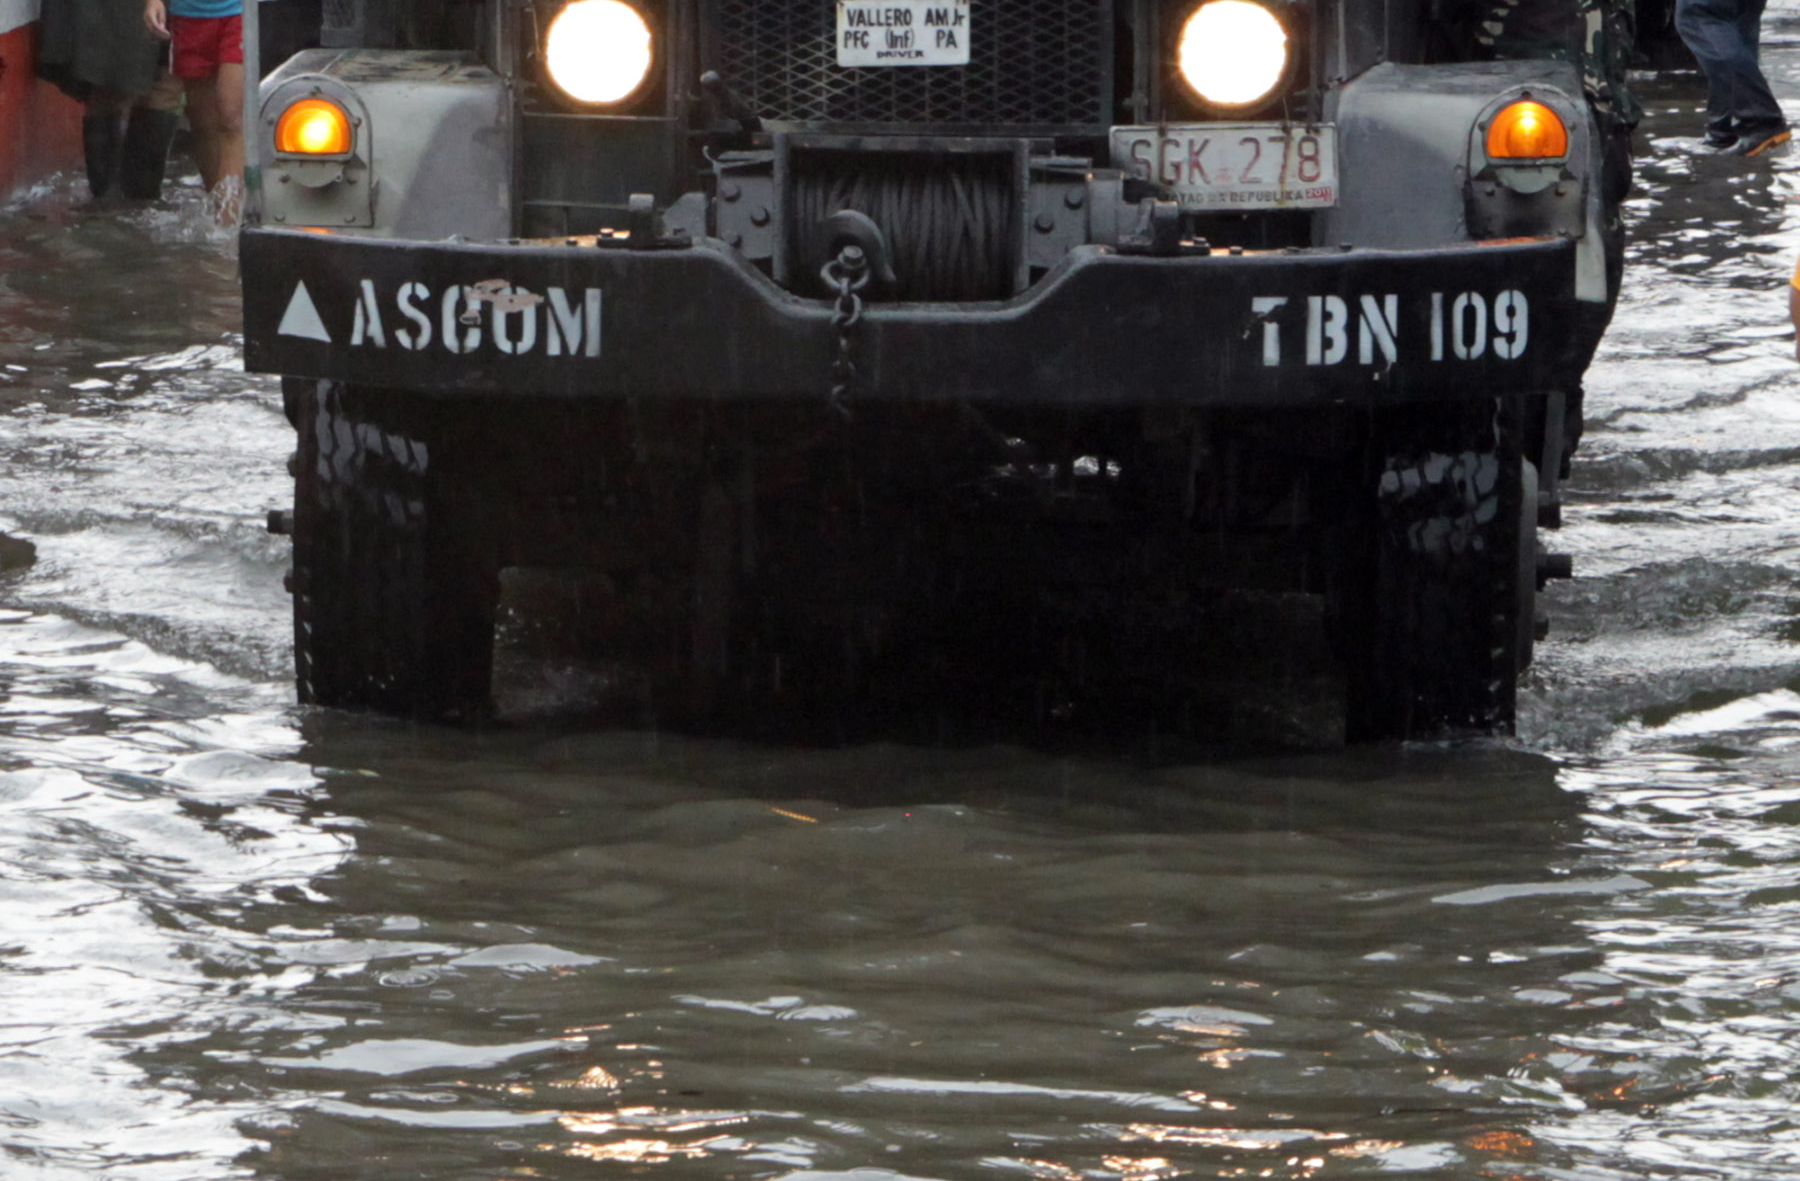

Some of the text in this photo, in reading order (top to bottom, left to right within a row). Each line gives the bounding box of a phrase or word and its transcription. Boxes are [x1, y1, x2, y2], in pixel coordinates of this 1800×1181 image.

[846, 8, 913, 28] VALLERO
[843, 30, 870, 49] PFC
[935, 29, 959, 49] PA
[876, 50, 925, 59] DRIVER
[1130, 135, 1322, 186] SGK 278
[1229, 189, 1303, 204] REPUBLIKA
[350, 278, 602, 357] ASCOM
[1251, 289, 1529, 367] TBN 109
